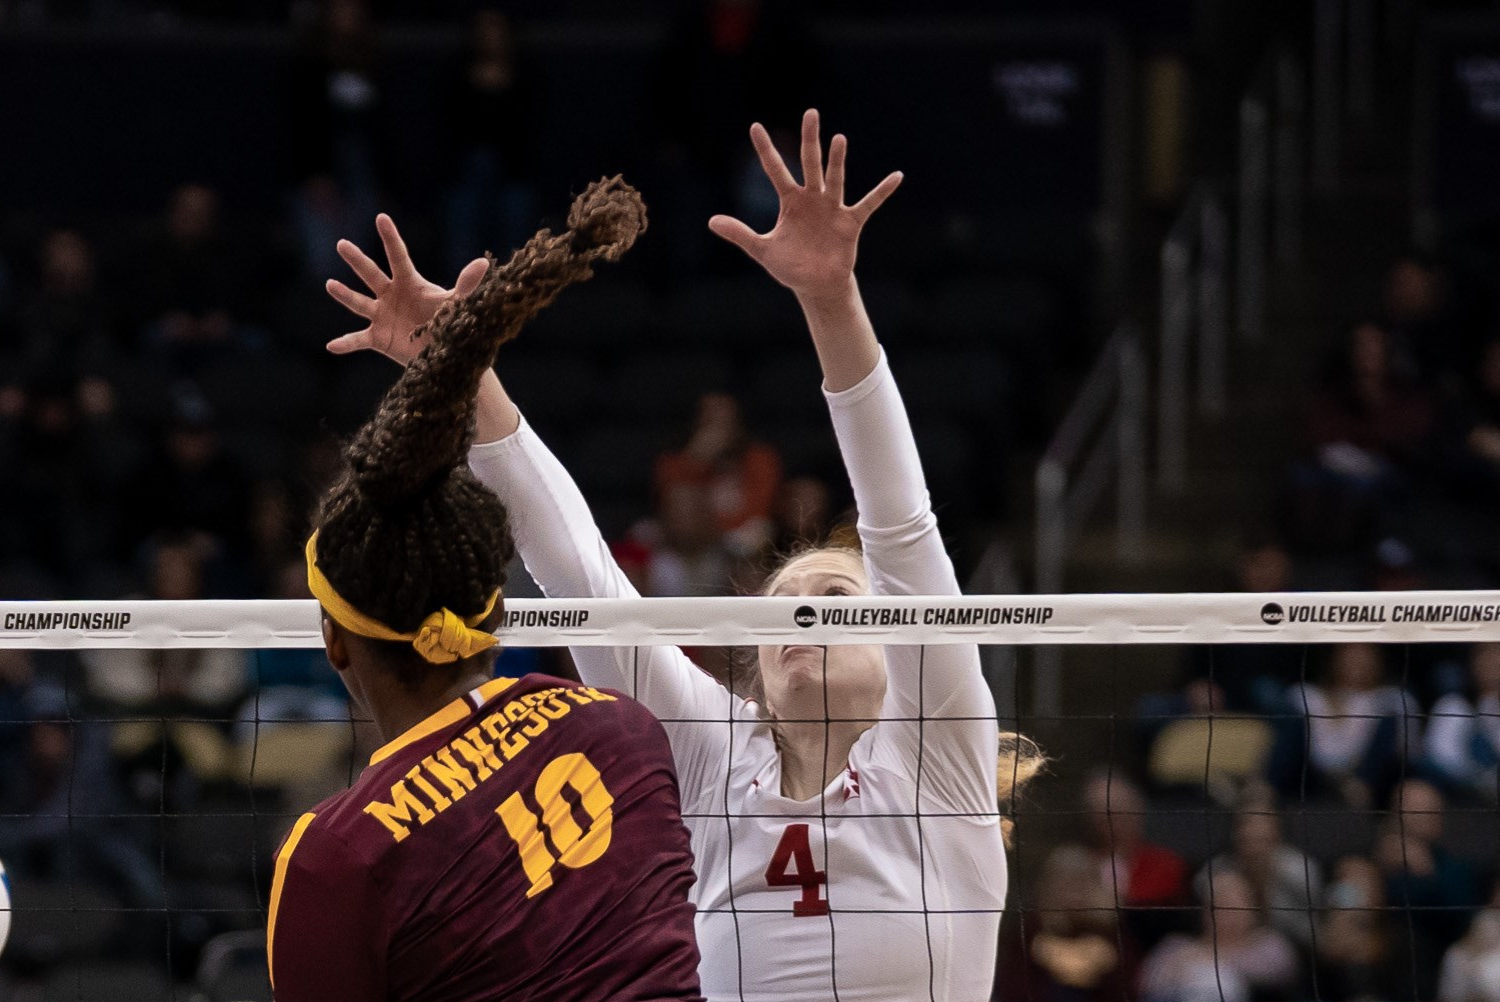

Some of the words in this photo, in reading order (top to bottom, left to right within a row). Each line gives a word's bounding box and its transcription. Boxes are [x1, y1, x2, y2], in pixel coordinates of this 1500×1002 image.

[4, 612, 131, 630] CHAMPIONSHIP
[821, 608, 918, 625] VOLLEYBALL
[923, 607, 1053, 625] CHAMPIONSHIP
[1288, 605, 1386, 623] VOLLEYBALL
[494, 752, 615, 899] 10
[764, 823, 830, 918] 4
